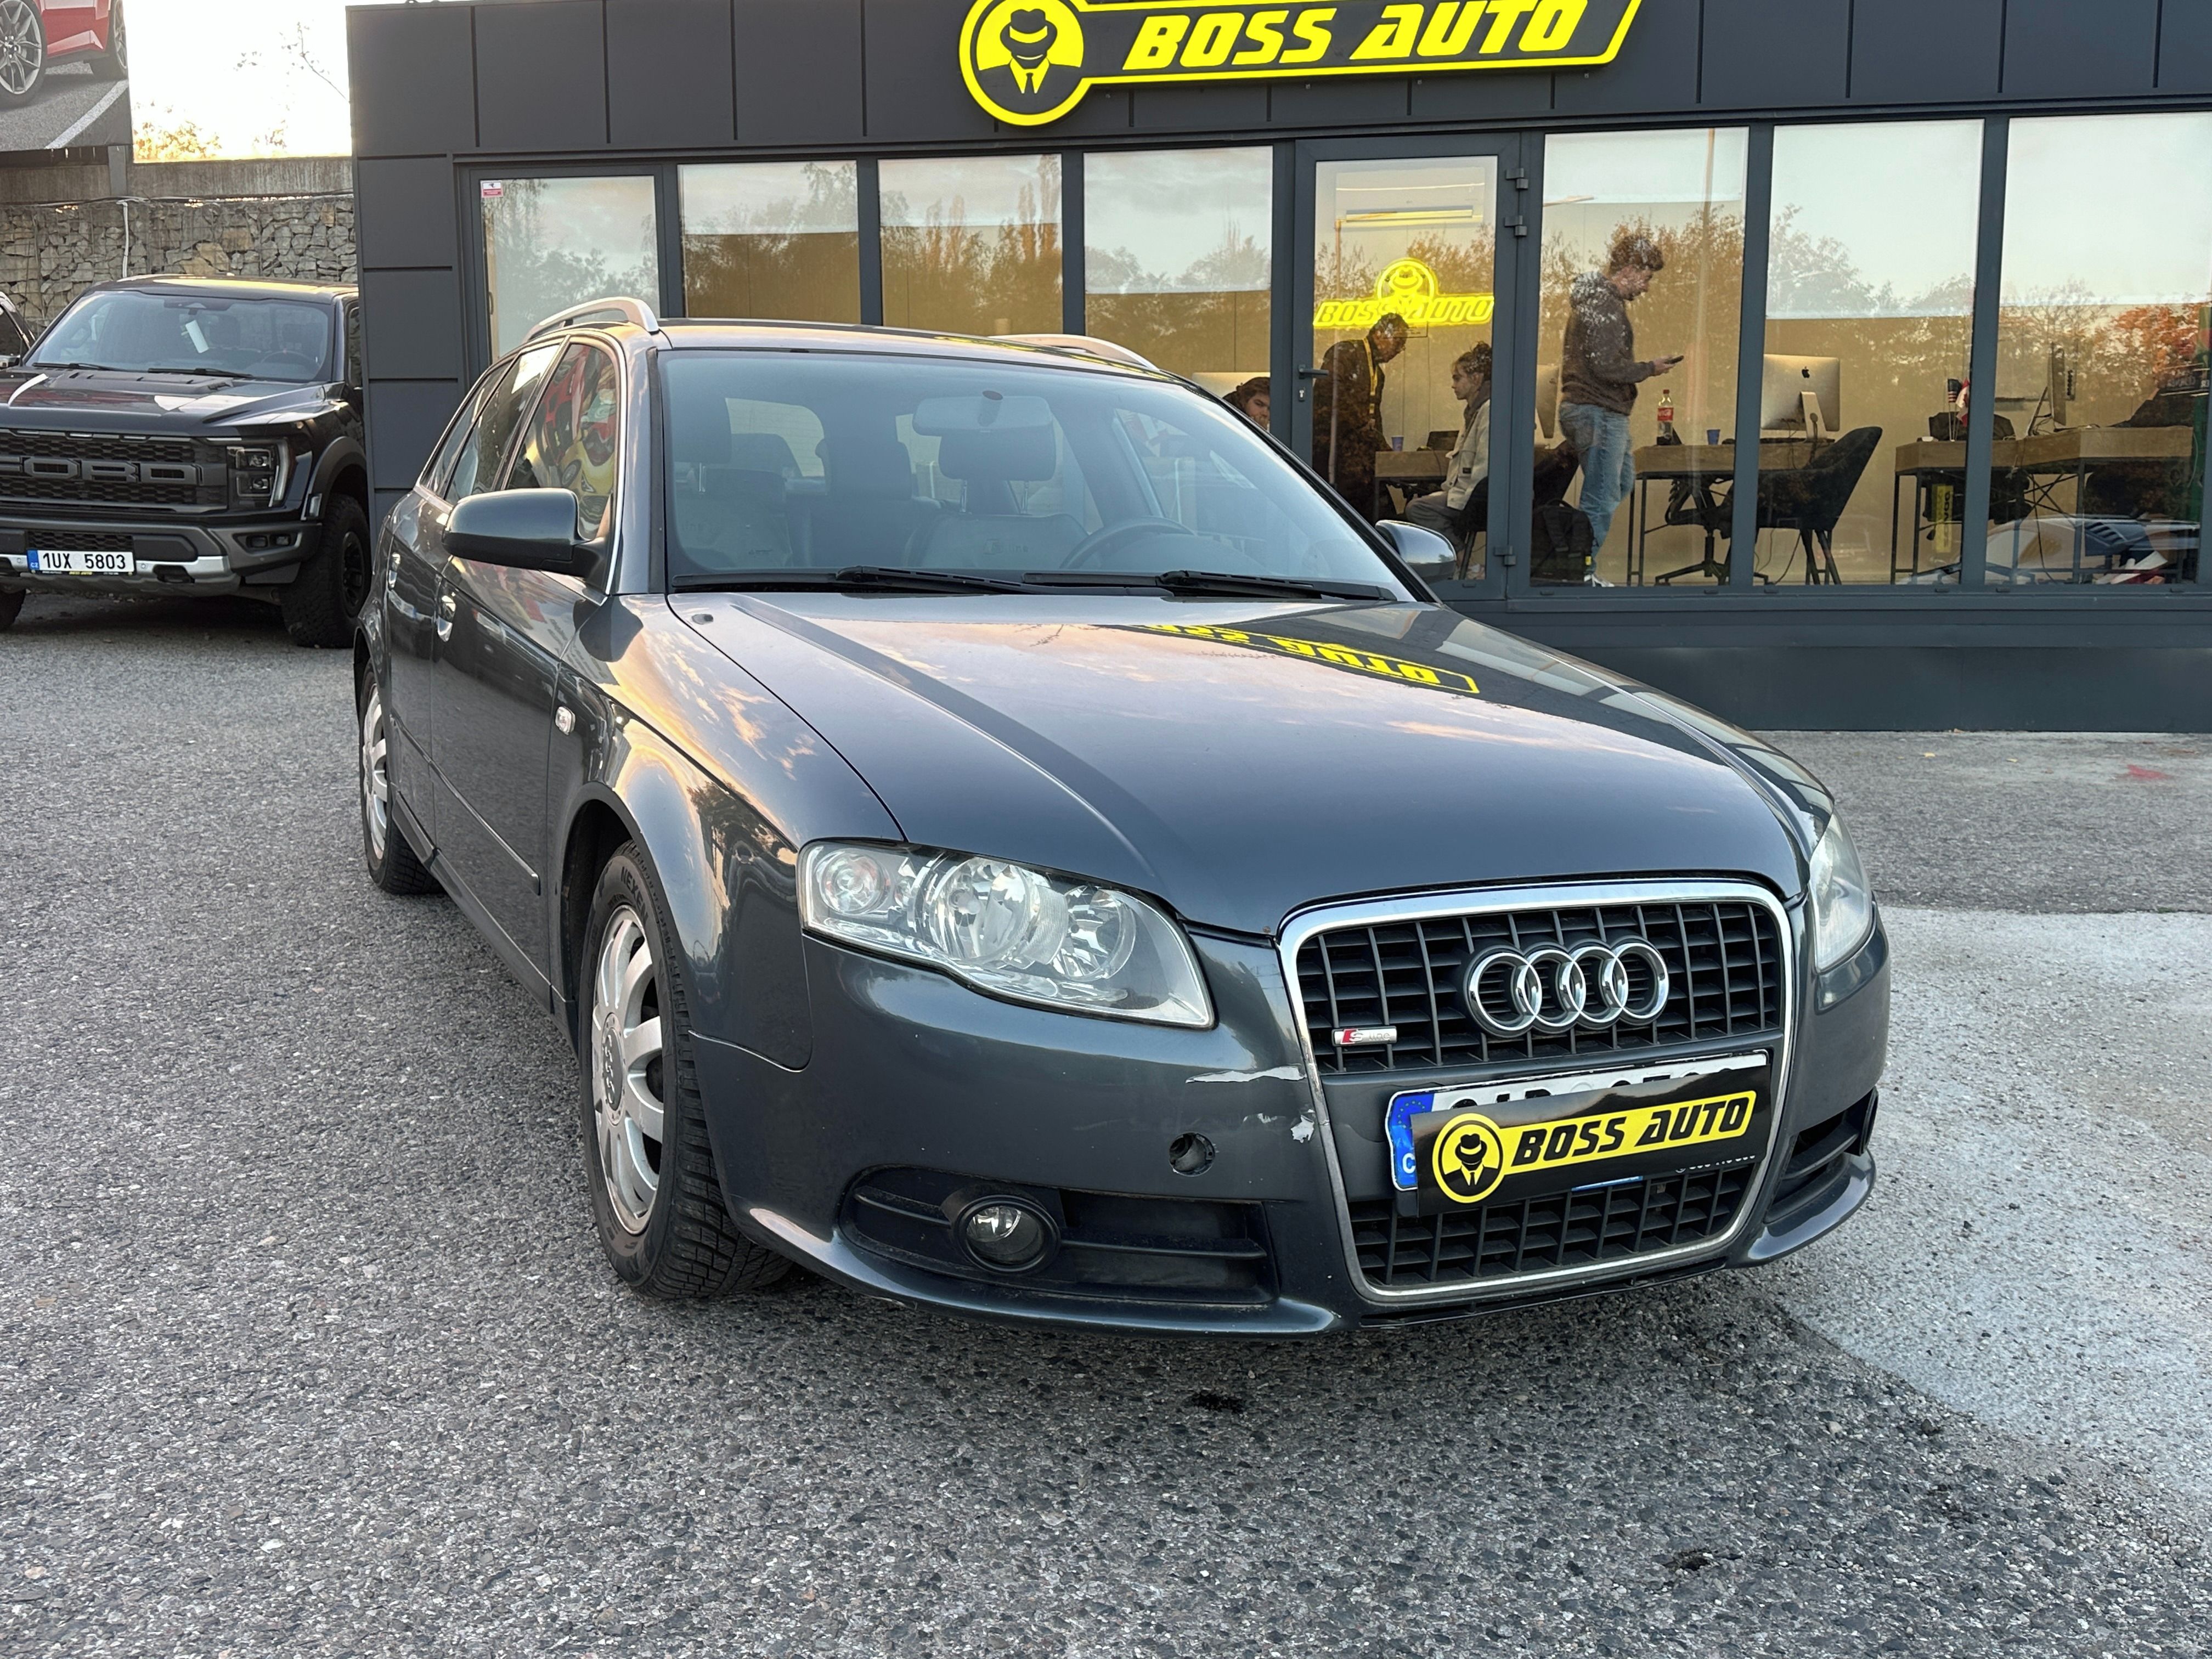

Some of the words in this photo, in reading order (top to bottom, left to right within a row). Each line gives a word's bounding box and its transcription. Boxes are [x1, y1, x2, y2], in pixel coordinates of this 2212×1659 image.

[1122, 8, 1338, 70] BOSS
[1348, 0, 1588, 60] AUTO
[43, 552, 72, 569] 1UX
[84, 554, 126, 569] 5803
[620, 866, 648, 927] NEXEN
[1348, 1031, 1364, 1042] S
[1510, 1116, 1627, 1166] BOSS
[1634, 1096, 1750, 1147] AUTO
[1402, 1152, 1416, 1173] C
